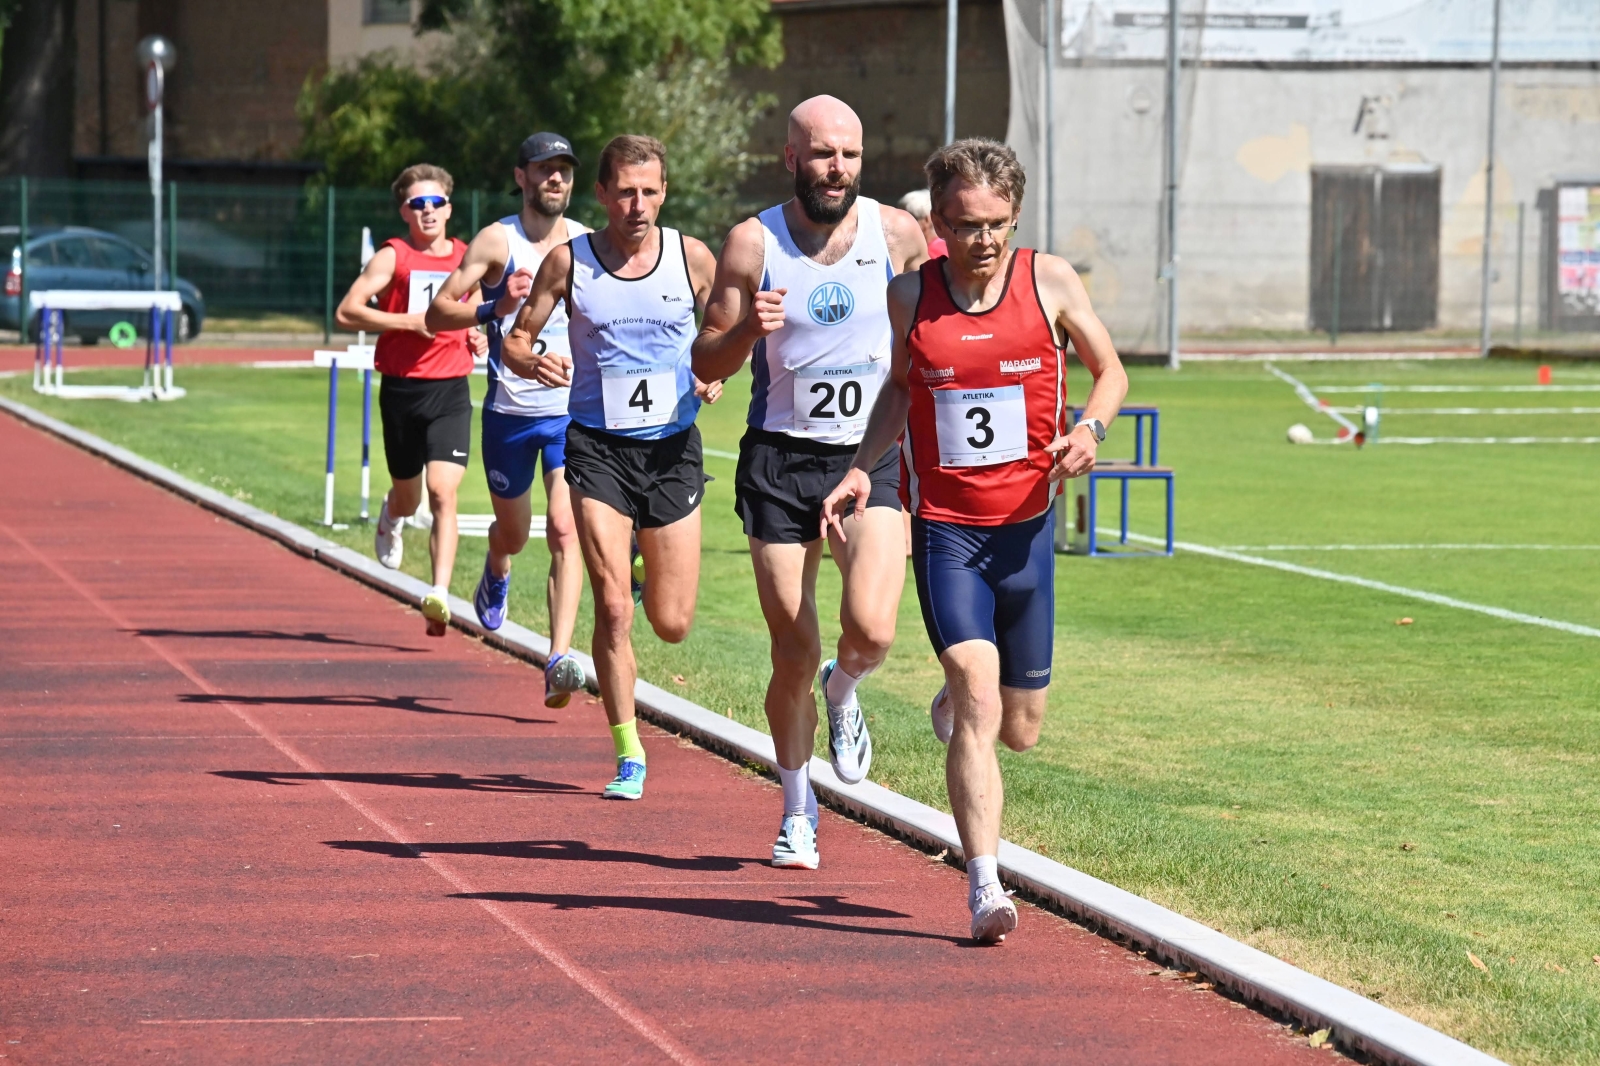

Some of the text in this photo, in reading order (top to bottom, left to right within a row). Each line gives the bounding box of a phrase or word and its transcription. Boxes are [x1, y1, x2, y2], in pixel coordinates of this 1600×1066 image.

[612, 316, 644, 326] Králové
[645, 317, 661, 325] nad
[1000, 357, 1041, 368] MARATON
[626, 367, 653, 375] ATLETIKA
[823, 368, 853, 376] ATLETIKA
[628, 379, 653, 413] 4
[808, 380, 863, 418] 20
[962, 392, 994, 400] ATLETIKA
[965, 406, 995, 449] 3
